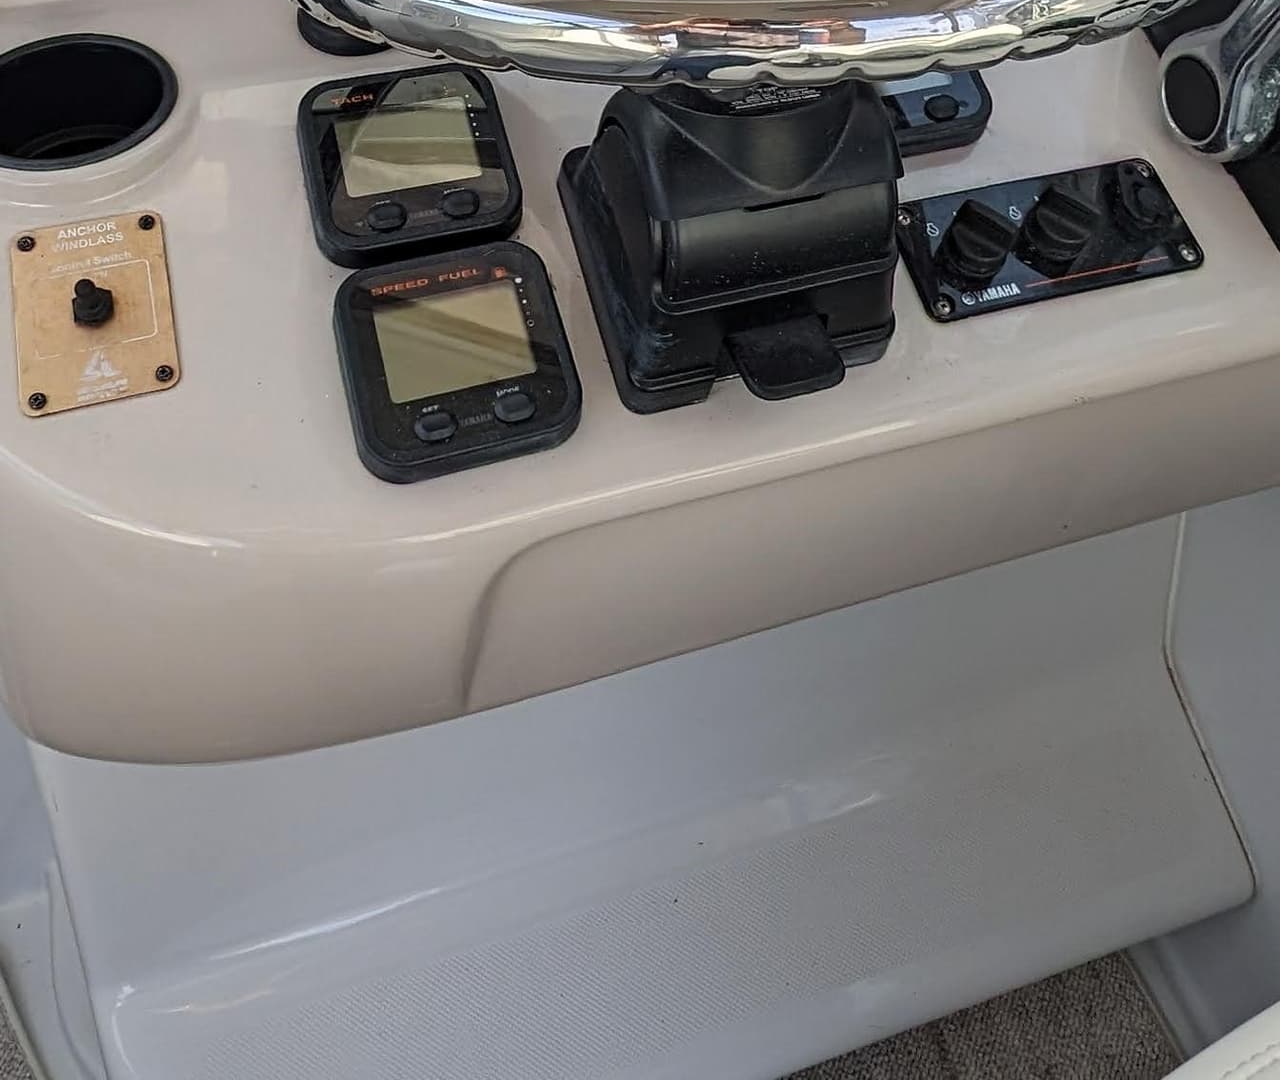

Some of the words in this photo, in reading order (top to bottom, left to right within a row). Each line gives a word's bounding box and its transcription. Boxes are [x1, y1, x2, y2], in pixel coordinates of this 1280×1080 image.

[330, 93, 374, 106] TACH
[57, 221, 117, 240] ANCHOR
[92, 251, 132, 266] Switch
[371, 278, 429, 297] SPEED
[438, 268, 481, 283] FUEL
[976, 283, 1021, 304] YAMAHA
